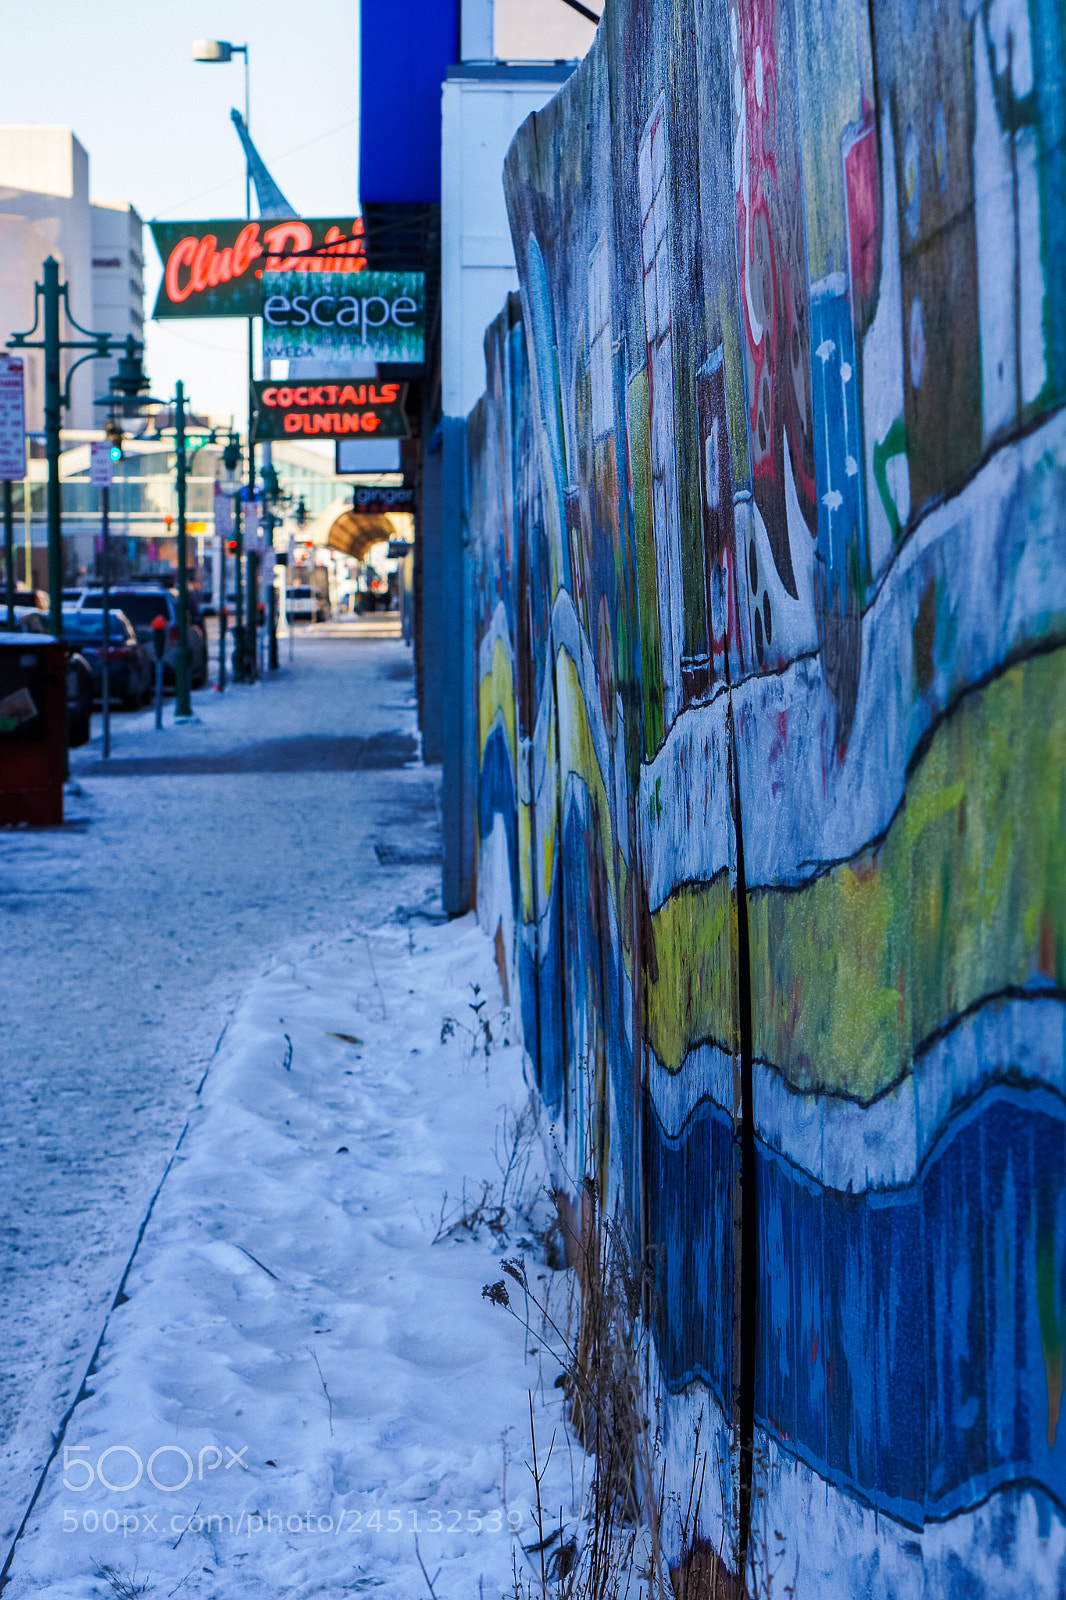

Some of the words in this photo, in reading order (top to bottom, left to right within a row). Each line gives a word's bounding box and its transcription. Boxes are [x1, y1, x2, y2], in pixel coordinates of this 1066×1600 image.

[165, 222, 264, 303] Club
[263, 294, 418, 345] escape
[262, 384, 400, 408] COCKTAILS
[284, 411, 381, 434] DINING
